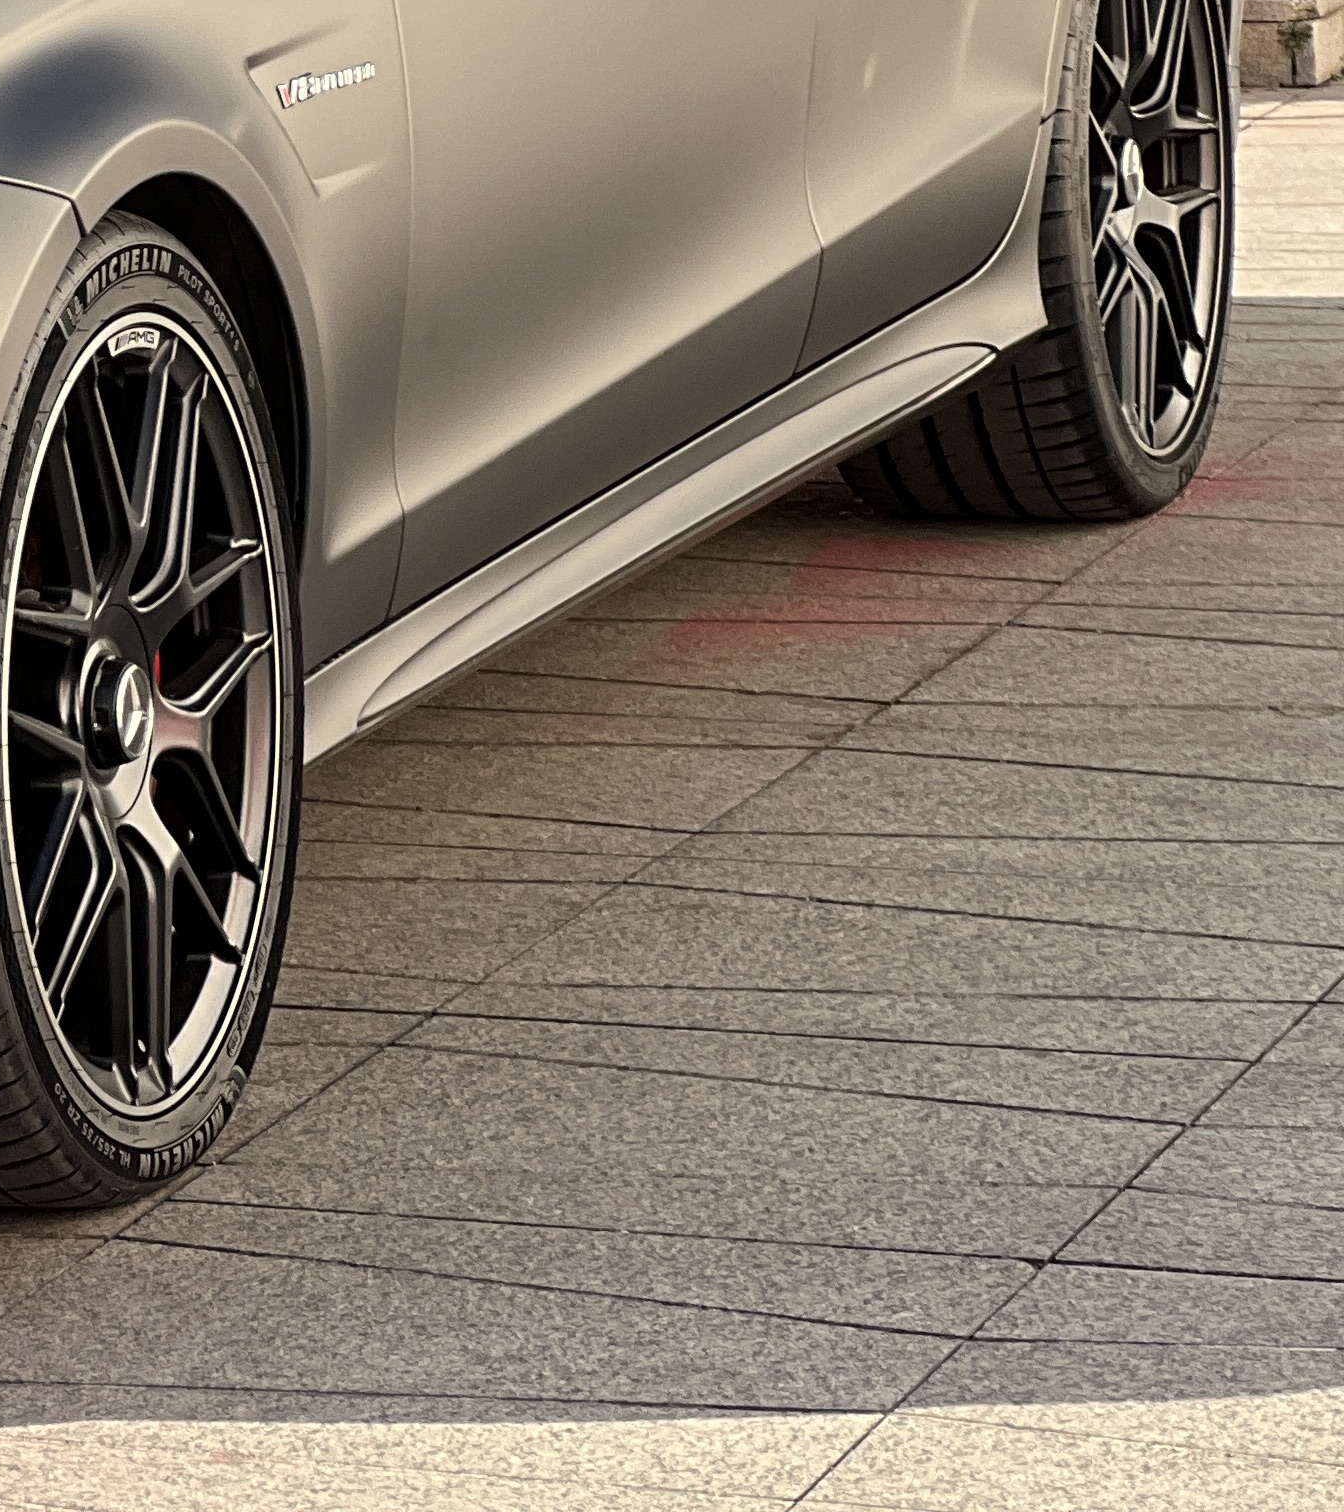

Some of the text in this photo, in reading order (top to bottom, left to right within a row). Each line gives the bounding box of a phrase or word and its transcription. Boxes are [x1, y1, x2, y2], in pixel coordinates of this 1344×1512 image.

[85, 247, 173, 306] MICHELIN
[177, 263, 204, 294] PILOT
[204, 289, 232, 333] SPORT
[138, 1102, 225, 1178] MICHELIN
